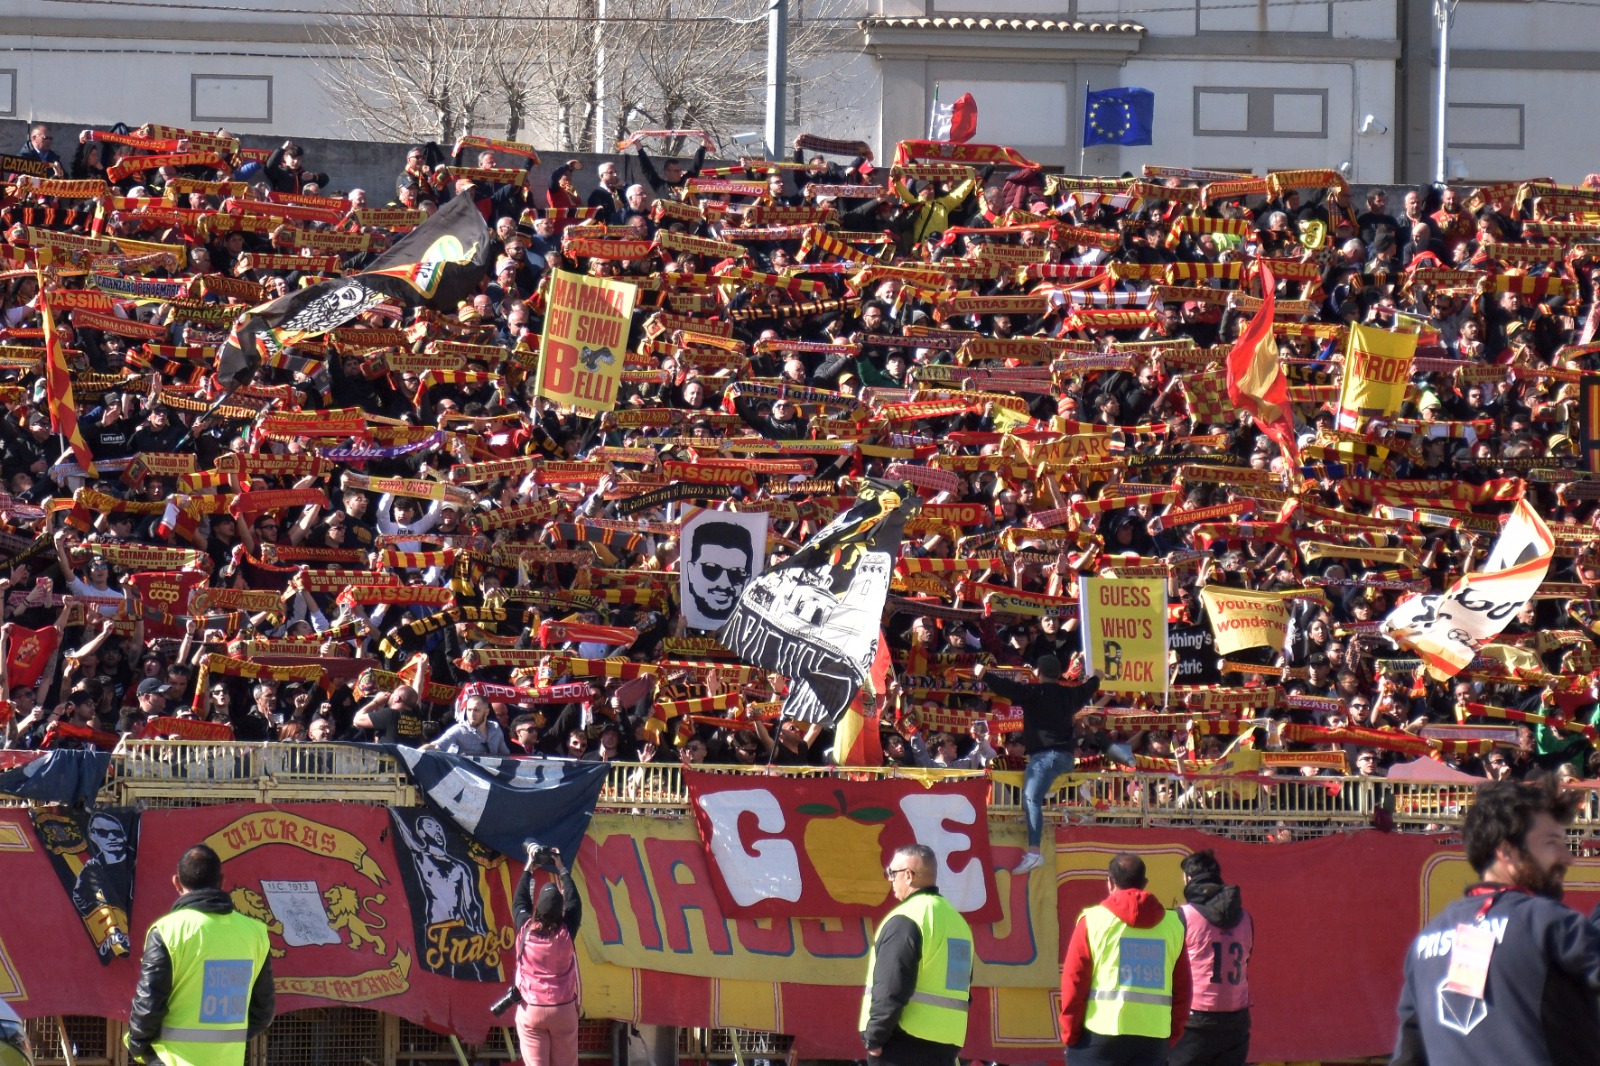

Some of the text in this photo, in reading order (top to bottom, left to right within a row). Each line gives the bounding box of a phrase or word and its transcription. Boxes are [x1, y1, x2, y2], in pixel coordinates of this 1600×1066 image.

[178, 134, 214, 145] CATANZARO
[122, 154, 220, 171] MASSIMO
[1210, 180, 1266, 192] MAMMACINEM
[374, 212, 404, 220] CATANZARO
[50, 234, 86, 245] CATANZARO
[88, 239, 102, 248] 1929
[315, 232, 346, 244] CATANZARO
[682, 235, 718, 249] CATANZARO
[720, 241, 737, 252] 1929
[571, 241, 648, 258] MASSIMO
[993, 248, 1026, 256] CATANZARO
[1508, 246, 1538, 255] CATANZARO
[96, 278, 138, 292] CATANZARO
[552, 280, 624, 318] MAMMA
[958, 298, 1046, 311] ULTRAS 1973
[550, 308, 621, 348] CHI SIMU
[444, 344, 500, 356] CATANZARO 1929
[972, 340, 1041, 357] ULTRAS
[406, 356, 441, 366] CATANZARO
[442, 356, 459, 366] 1929
[543, 340, 613, 402] BELLI
[486, 462, 513, 473] CATANZARO
[548, 462, 604, 472] CATANZARO 1929
[1189, 467, 1258, 482] ULTRAS
[405, 481, 434, 494] OVEST
[500, 505, 533, 520] CATANZARO
[534, 500, 550, 512] 1929
[102, 548, 185, 561] U.S. CATANZARO 1929
[354, 587, 453, 604] MASSIMO
[1100, 586, 1151, 607] GUESS
[1216, 600, 1262, 614] you're
[1101, 621, 1152, 640] WHO'S
[269, 644, 308, 654] CATANZARO
[310, 645, 322, 654] 192
[1104, 640, 1153, 682] BACK
[722, 668, 740, 677] 1929
[1224, 694, 1253, 702] CATANZARO
[1130, 715, 1172, 724] CATANZARO
[222, 818, 338, 853] ULTRAS
[287, 881, 310, 891] 1973
[1121, 939, 1163, 962] STEWARD
[1210, 941, 1244, 987] 13
